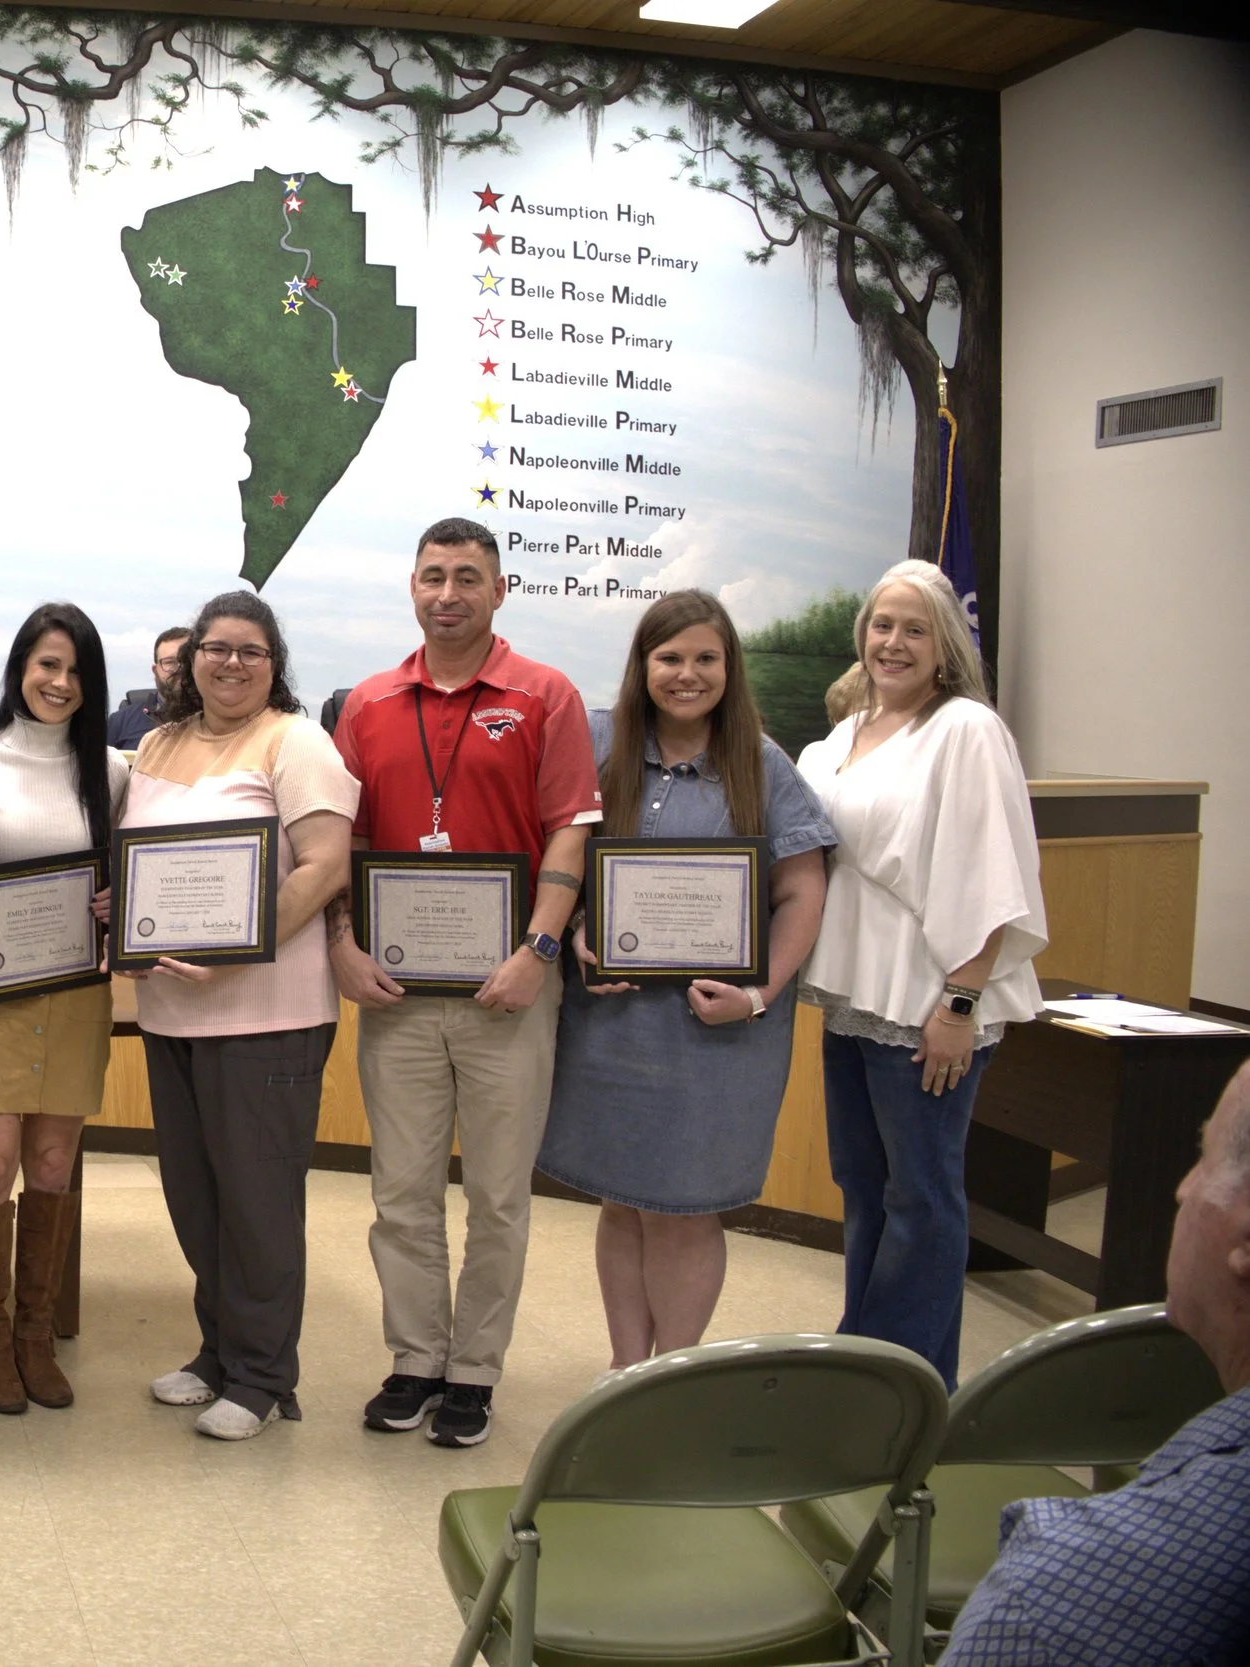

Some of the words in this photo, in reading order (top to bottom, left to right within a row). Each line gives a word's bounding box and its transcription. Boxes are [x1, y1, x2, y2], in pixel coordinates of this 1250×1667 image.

[510, 195, 608, 221] Assumption
[617, 203, 655, 226] High
[511, 236, 566, 259] Bayou
[638, 246, 698, 272] Primary
[511, 277, 554, 299] Belle
[561, 281, 605, 303] Rose
[612, 285, 667, 308] Middle
[511, 319, 553, 341] Belle
[561, 323, 604, 345] Rose
[611, 326, 673, 352] Primary
[512, 362, 609, 387] Labadieville
[616, 370, 672, 392] Middle
[510, 404, 608, 429] Labadieville
[616, 410, 677, 436] Primary
[509, 446, 619, 472] Napoleonville
[625, 454, 681, 476] Middle
[509, 490, 618, 514] Napoleonville
[625, 495, 686, 520] Primary
[508, 532, 559, 554] Pierre
[565, 534, 600, 556] Part
[607, 537, 662, 559] Middle
[507, 574, 558, 596] Pierre
[564, 576, 598, 598] Part
